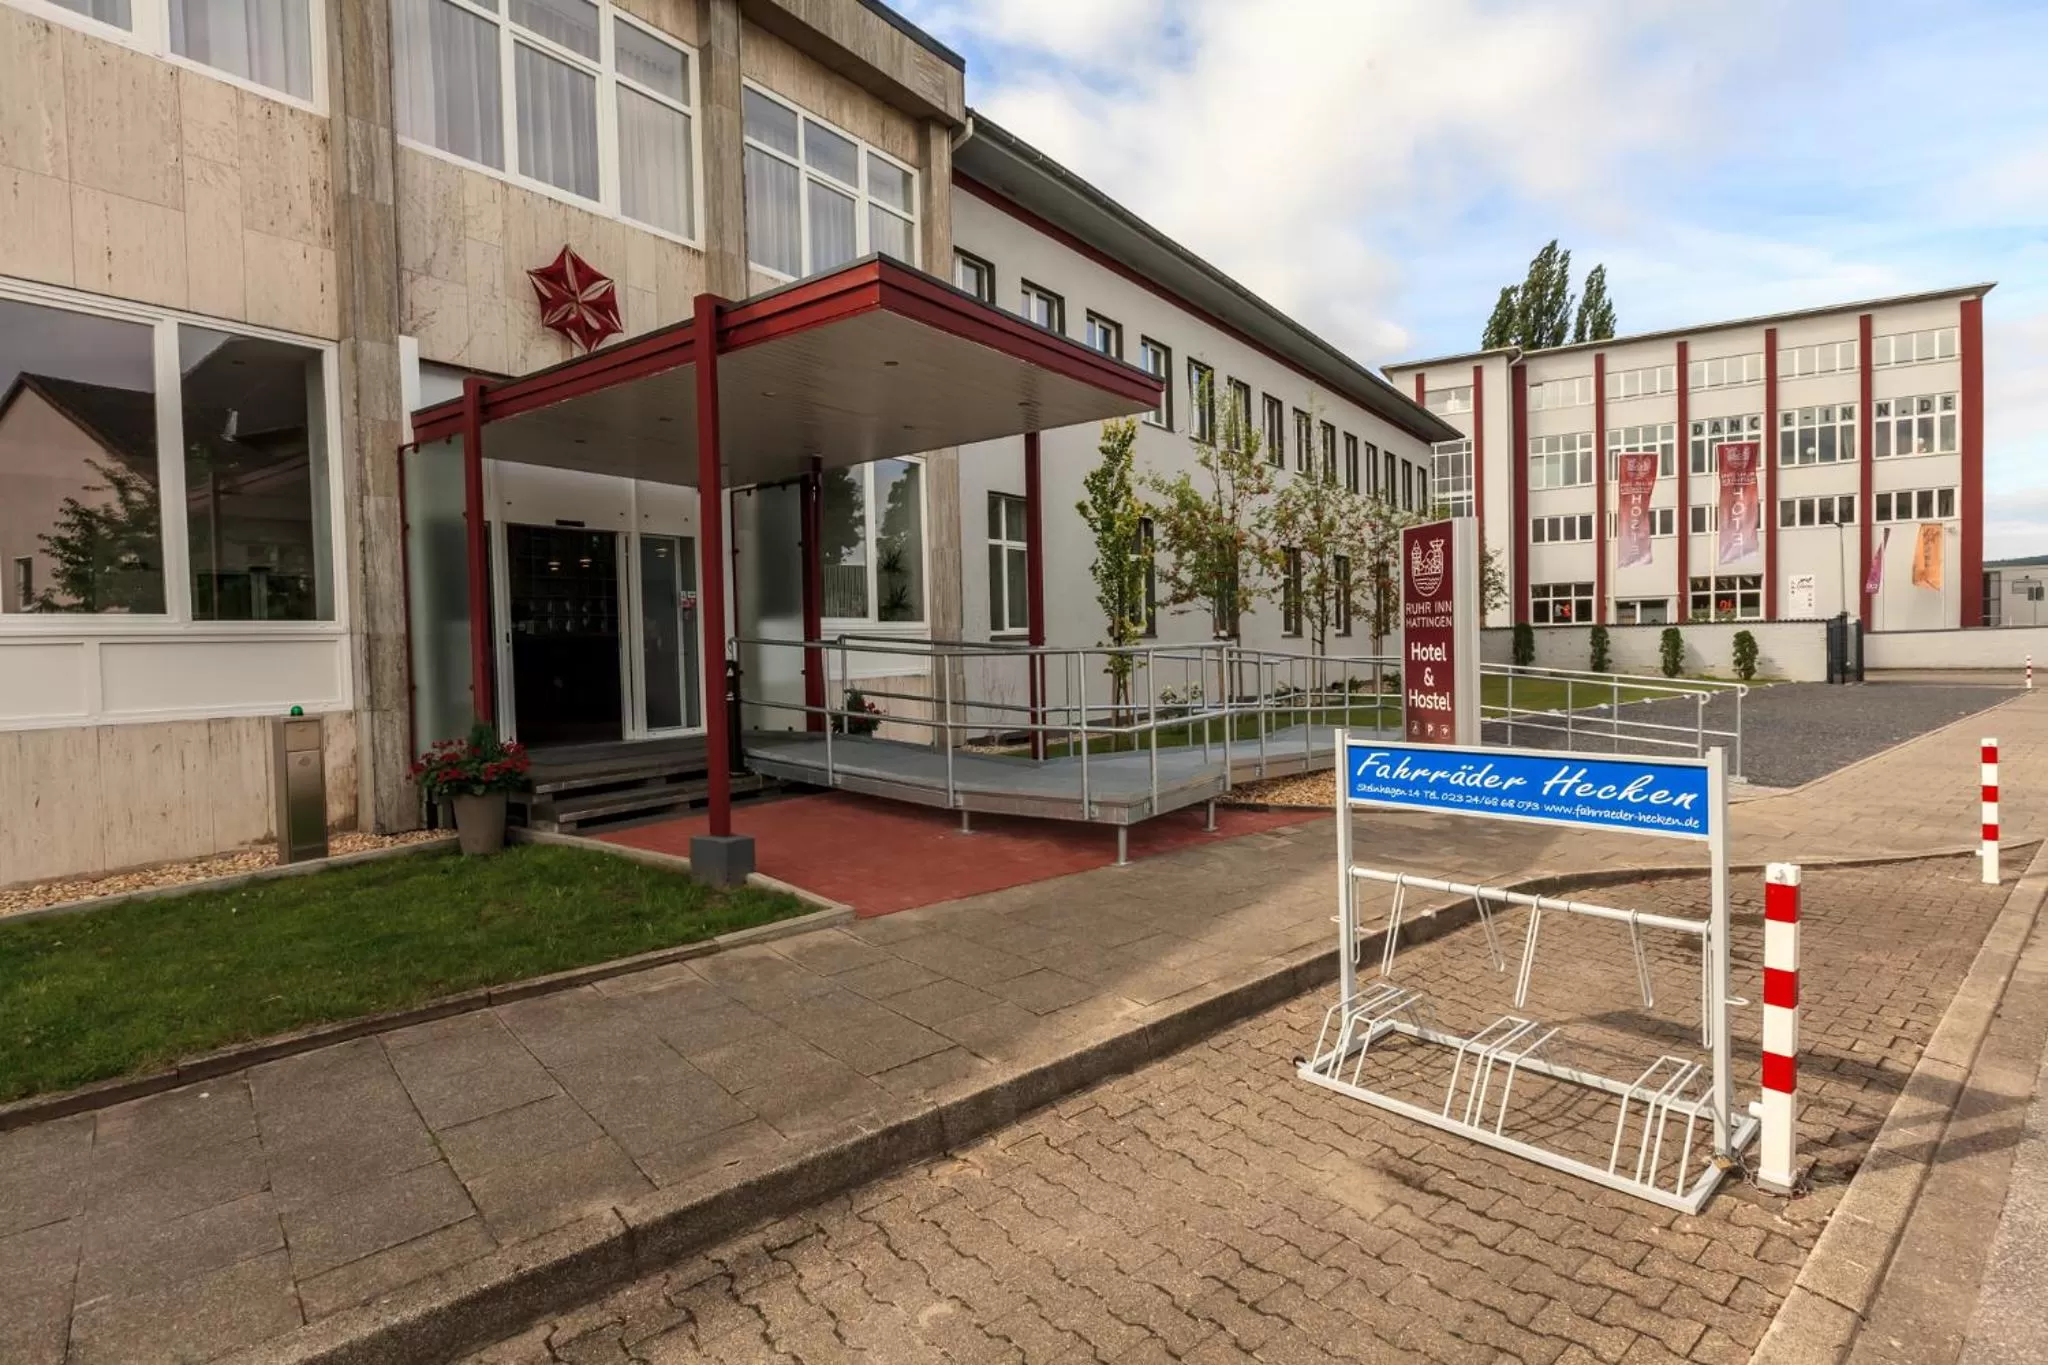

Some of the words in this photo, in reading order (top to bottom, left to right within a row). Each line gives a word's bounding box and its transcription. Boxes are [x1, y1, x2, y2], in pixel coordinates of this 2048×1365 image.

[1406, 601, 1432, 615] RUHR
[1434, 600, 1452, 613] INN
[1406, 616, 1452, 628] HATTINGEN
[1411, 642, 1447, 661] Hotel
[1423, 667, 1434, 687] &
[1408, 689, 1452, 711] Hostel
[1356, 752, 1528, 790] Fahrräder
[1541, 765, 1698, 811] Hecken
[1357, 783, 1408, 798] Steinhagen
[1408, 789, 1420, 797] 14
[1543, 805, 1700, 829] www.fahrraeder-hecken.de
